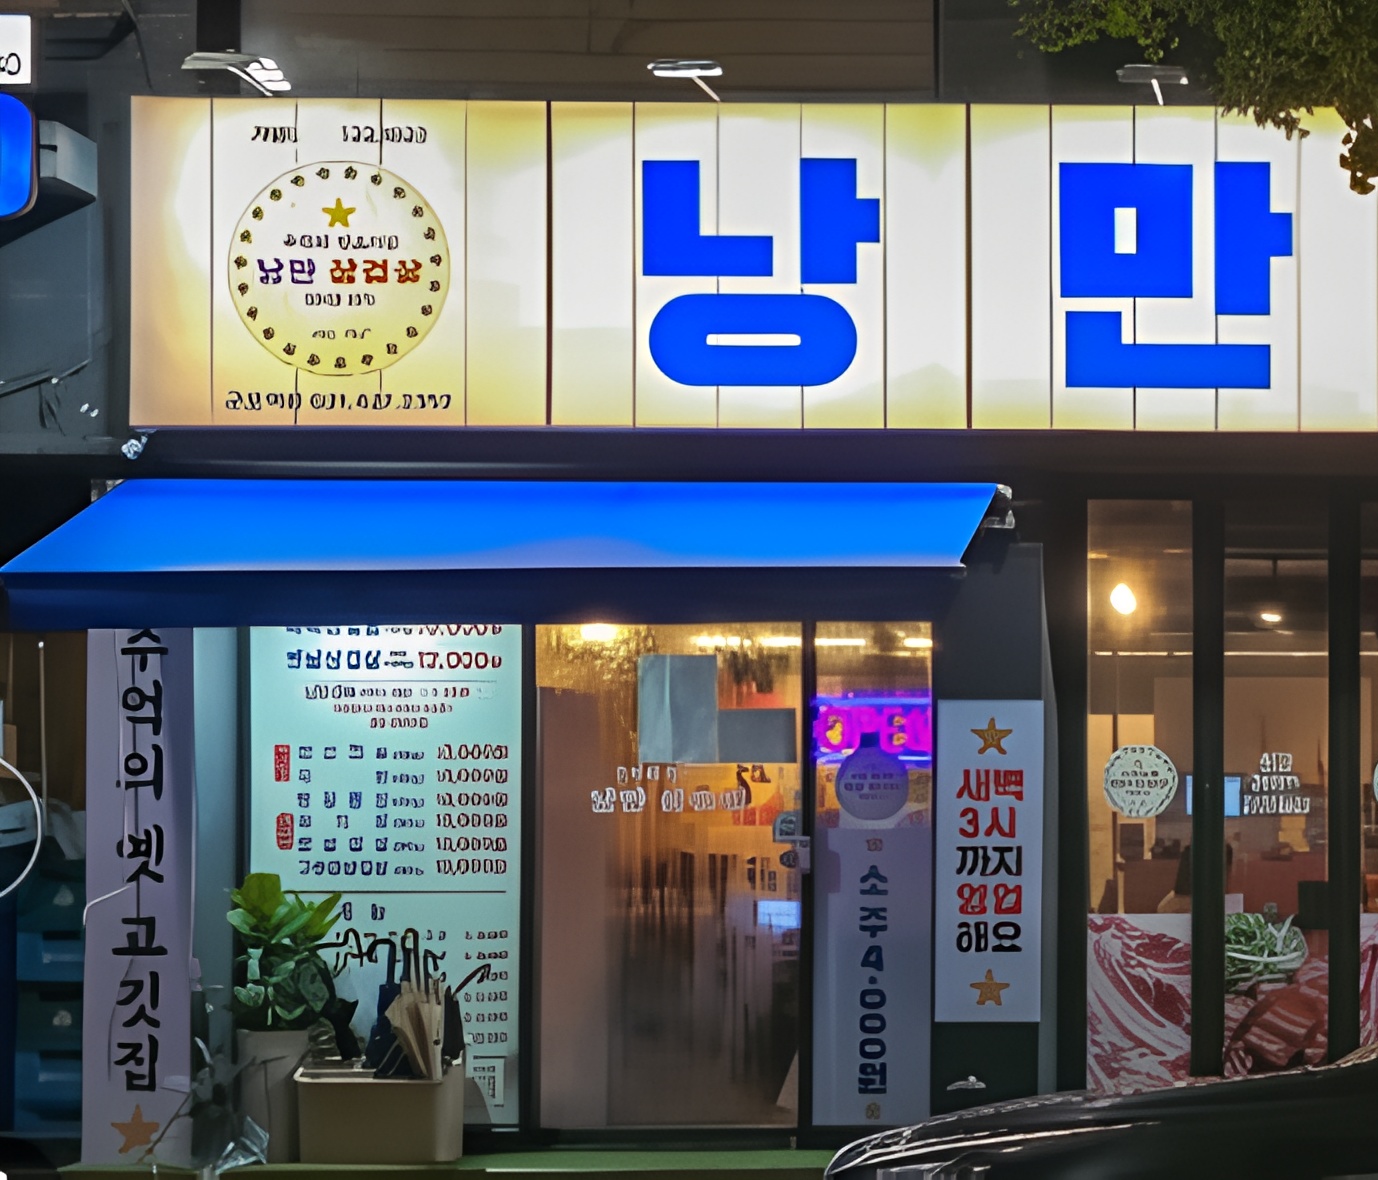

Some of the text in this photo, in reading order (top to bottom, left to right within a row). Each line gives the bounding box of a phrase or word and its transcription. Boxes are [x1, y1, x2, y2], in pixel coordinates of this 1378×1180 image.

[642, 159, 1293, 389] 낭만
[956, 768, 1023, 802] 새벽
[958, 806, 1017, 838] 3시
[956, 845, 1023, 877] 까지
[956, 883, 1023, 916] 영업
[956, 920, 1023, 953] 해요
[112, 916, 168, 1092] 고깃집
